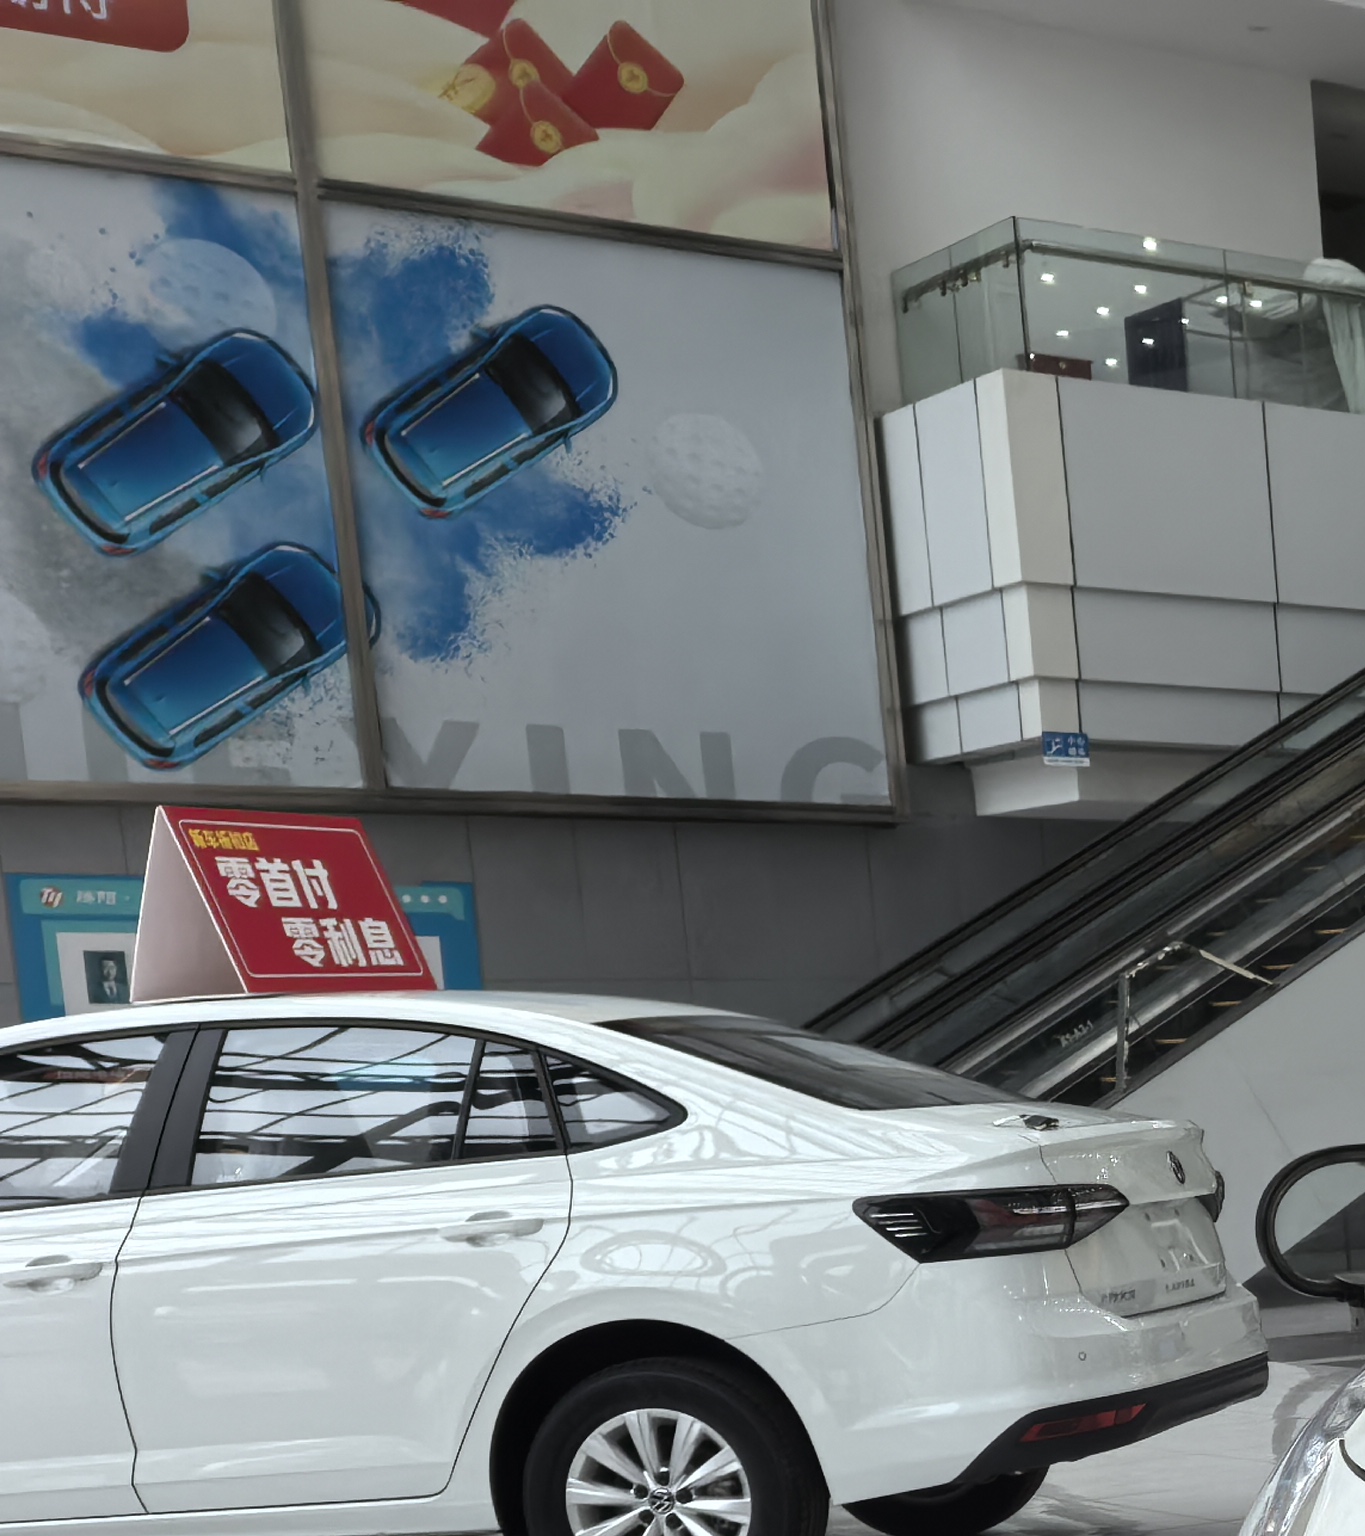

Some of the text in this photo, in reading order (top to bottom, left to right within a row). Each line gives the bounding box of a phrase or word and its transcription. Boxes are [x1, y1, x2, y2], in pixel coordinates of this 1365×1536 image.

[214, 856, 339, 910] 零首付
[281, 916, 405, 968] 零利息
